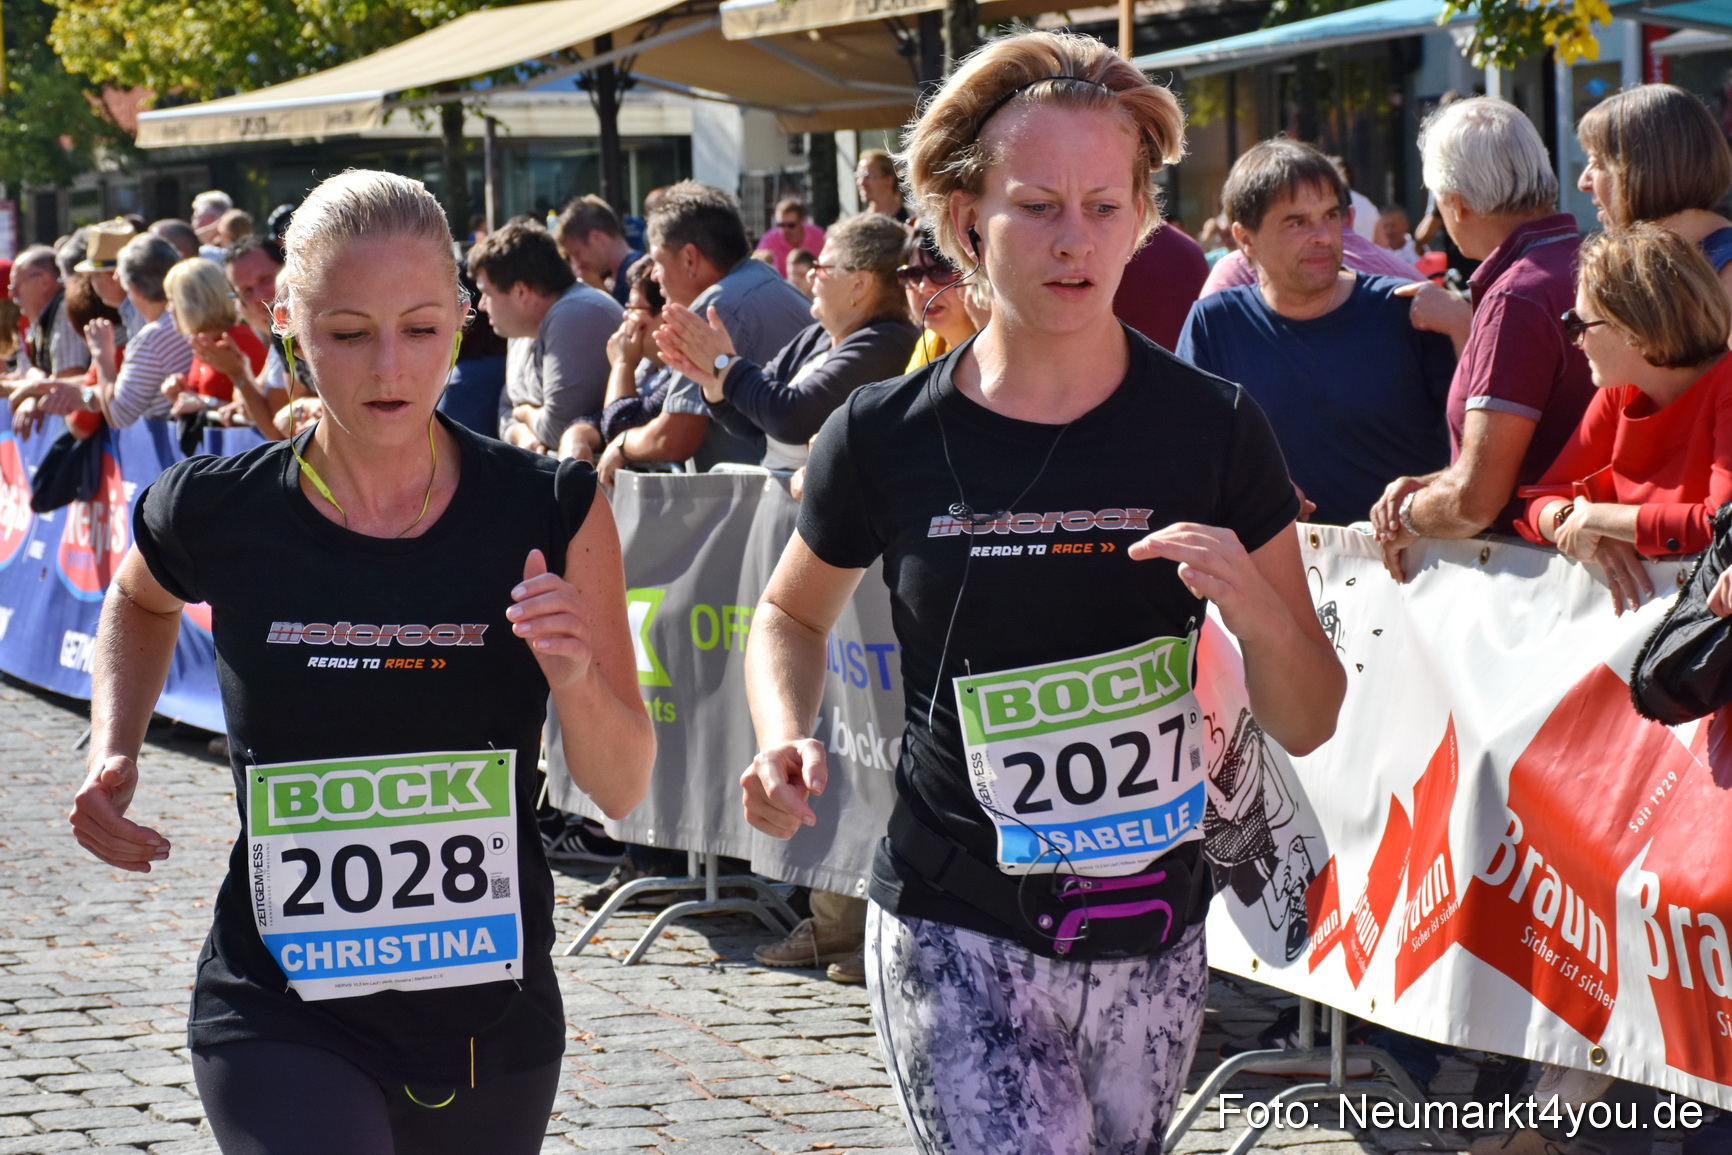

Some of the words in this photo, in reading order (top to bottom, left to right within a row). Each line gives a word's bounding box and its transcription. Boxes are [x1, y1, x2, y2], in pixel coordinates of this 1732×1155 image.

[927, 508, 1154, 537] motoroox
[970, 545, 1023, 557] READY
[1027, 545, 1046, 555] TO
[1052, 543, 1094, 554] RACE
[266, 621, 489, 646] motoroox
[307, 657, 358, 669] READY
[362, 658, 380, 669] TO
[385, 658, 425, 669] RACE
[979, 643, 1183, 733] BOCK
[1190, 712, 1197, 724] D
[1003, 713, 1185, 815] 2027
[269, 761, 492, 825] BOCK
[1629, 807, 1652, 833] Seit
[1650, 771, 1677, 805] 1929
[493, 838, 504, 849] D
[1038, 802, 1190, 857] ISABELLE
[281, 834, 488, 917] 2028
[1474, 805, 1608, 975] Braun
[281, 927, 497, 972] CHRISTINA
[1411, 927, 1430, 953] Sicher
[1430, 916, 1440, 934] ist
[1521, 925, 1560, 966] Sicher
[1560, 956, 1579, 980] ist
[1578, 975, 1616, 1010] sicher
